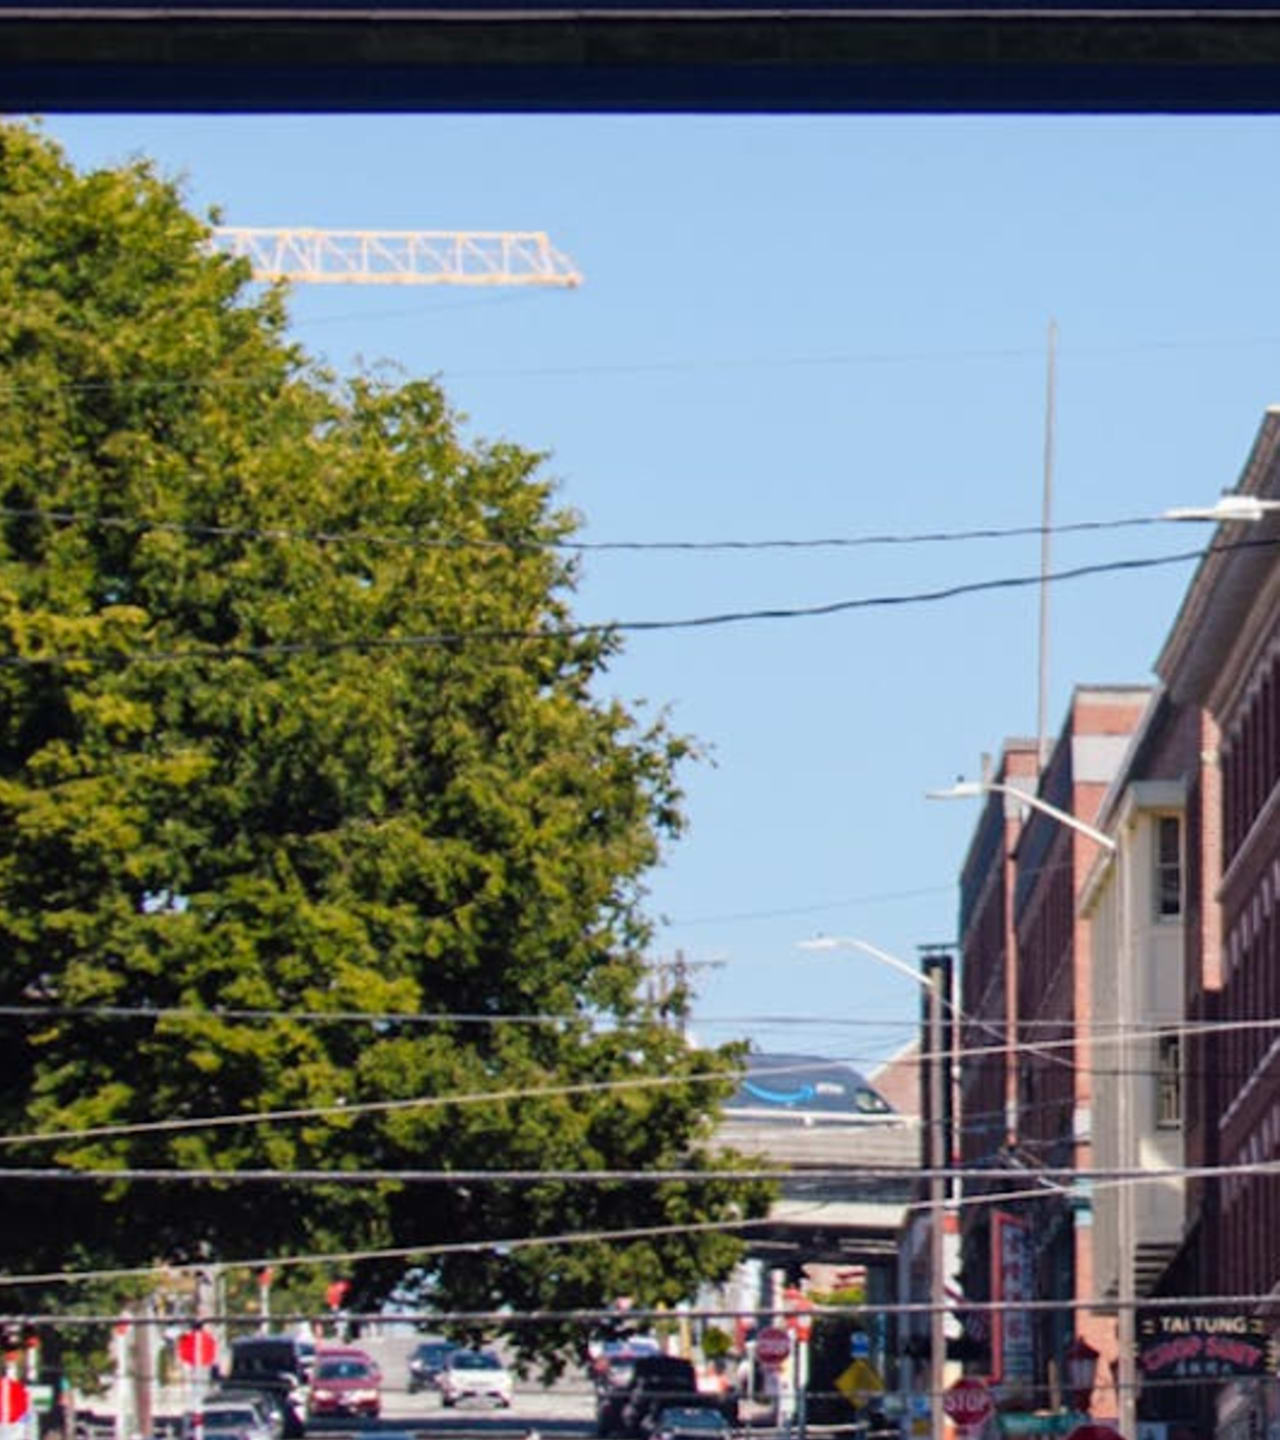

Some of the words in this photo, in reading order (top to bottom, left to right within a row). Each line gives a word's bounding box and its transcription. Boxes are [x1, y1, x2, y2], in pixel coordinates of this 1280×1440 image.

[1160, 1316, 1190, 1333] TAI
[1193, 1316, 1247, 1333] TUNG
[943, 1389, 989, 1411] STOP
